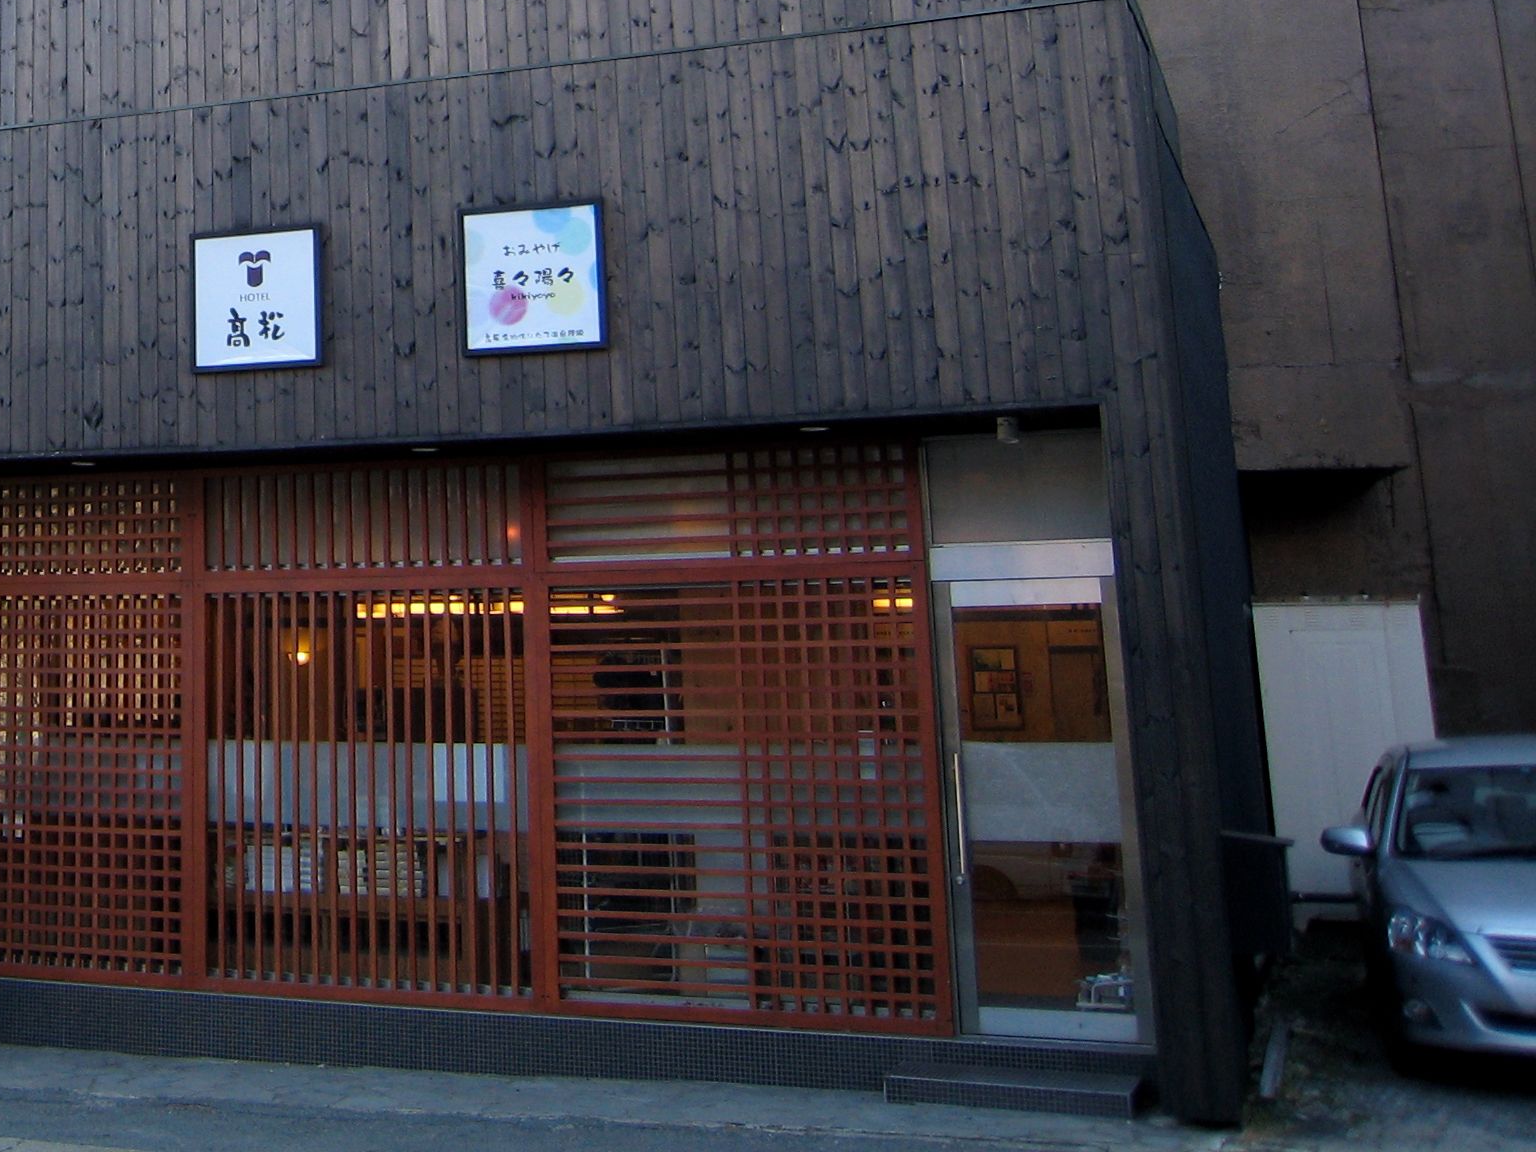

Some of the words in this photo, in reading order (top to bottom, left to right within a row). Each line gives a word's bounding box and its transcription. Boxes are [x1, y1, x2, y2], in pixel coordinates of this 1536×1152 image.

[502, 241, 561, 257] おみやげ
[492, 266, 575, 291] 喜々陽々
[240, 292, 271, 303] HOTEL
[510, 292, 556, 302] kikiyoyo
